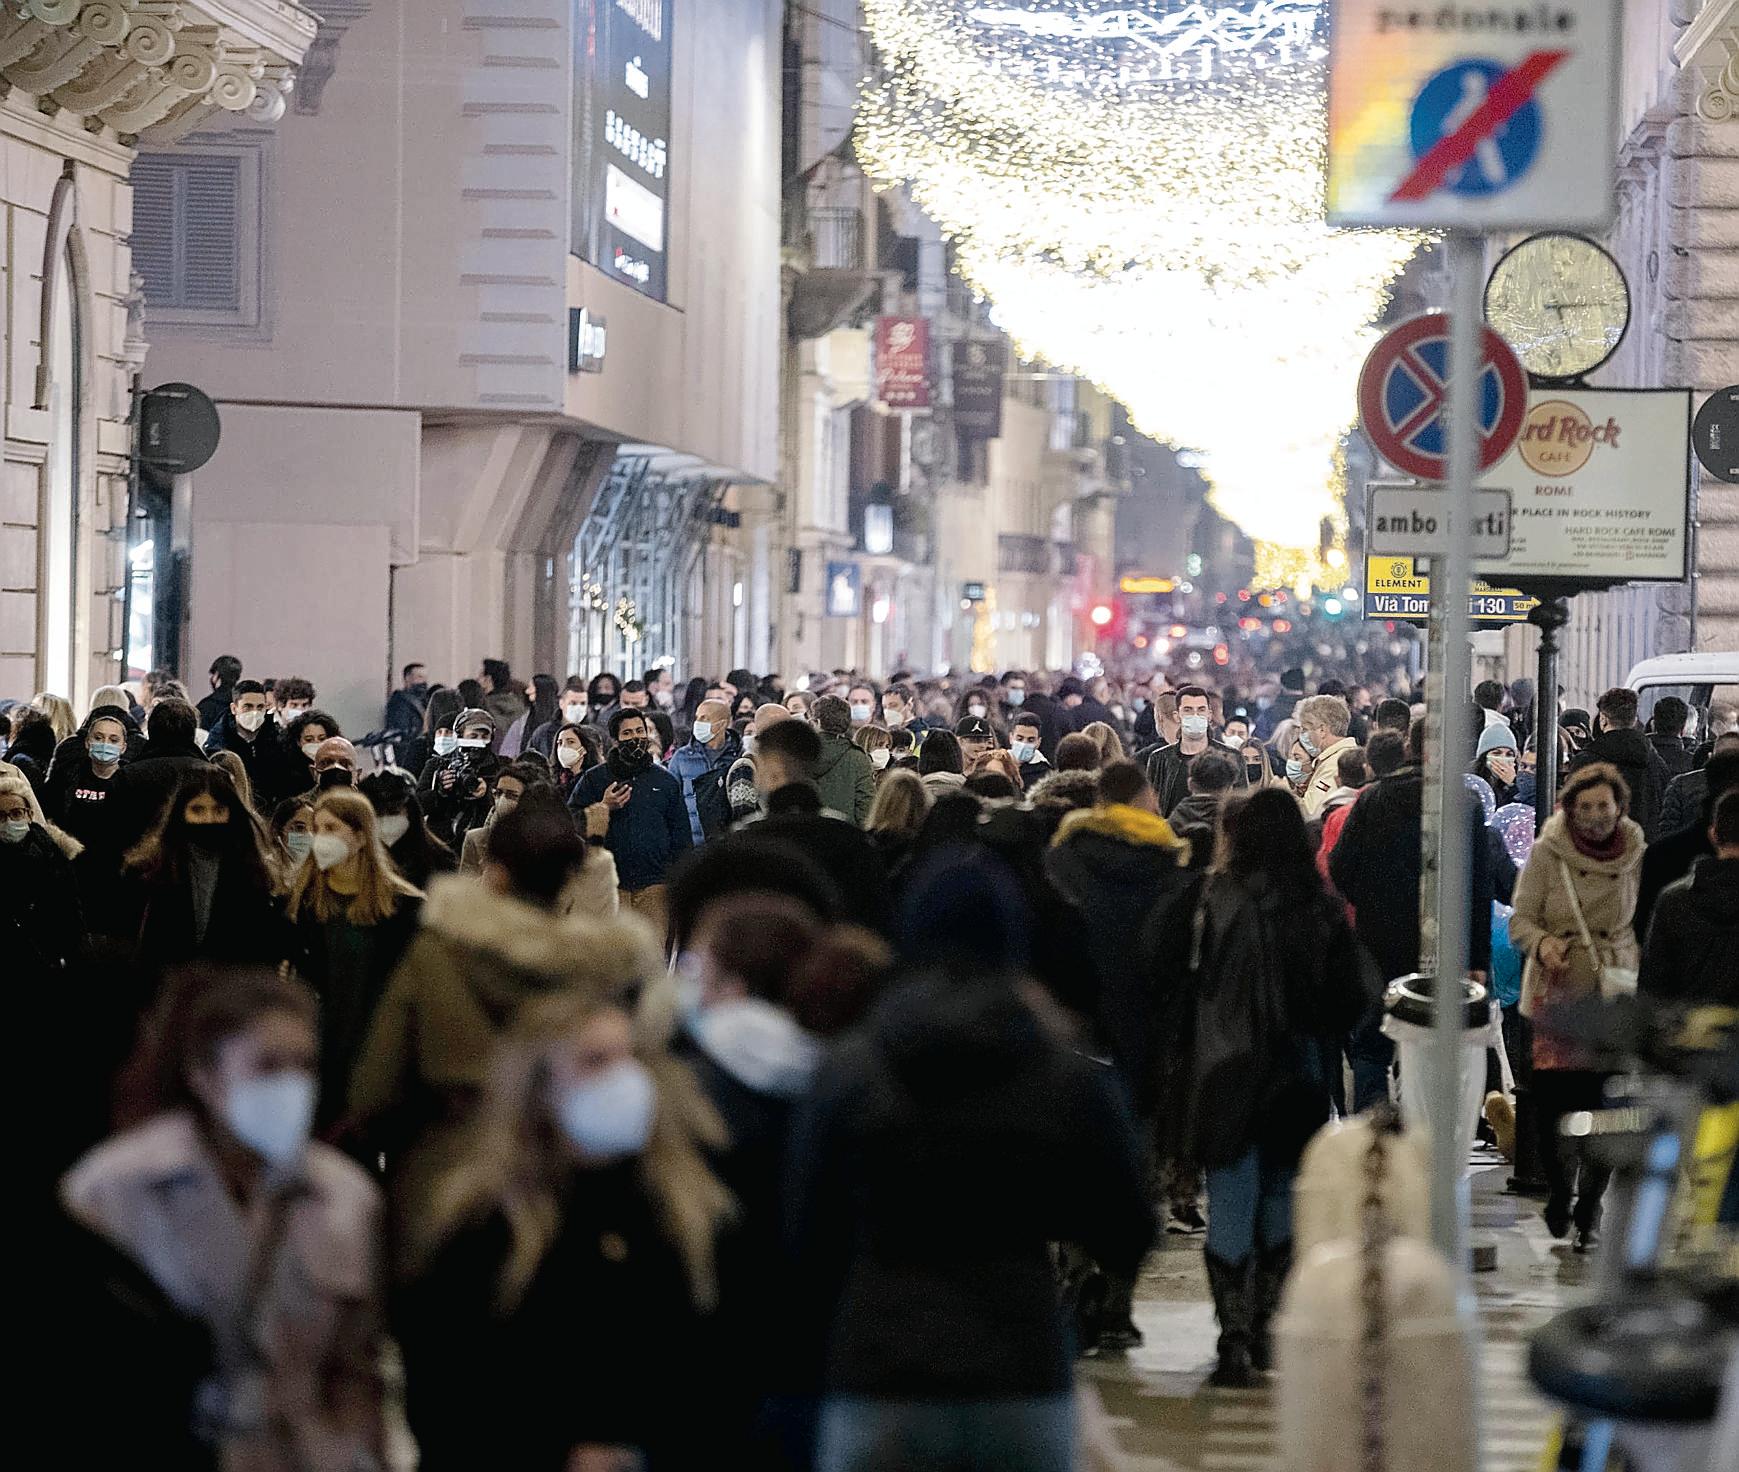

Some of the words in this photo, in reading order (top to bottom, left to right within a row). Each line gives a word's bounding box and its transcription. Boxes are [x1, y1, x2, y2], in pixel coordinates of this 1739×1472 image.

[1535, 485, 1574, 497] ROME
[1522, 507, 1552, 517] PLACE
[1557, 508, 1570, 517] IN
[1573, 508, 1601, 518] ROCK
[1606, 509, 1651, 519] HISTORY
[1376, 509, 1437, 535] ambo
[1648, 527, 1676, 537] ROME
[1375, 579, 1422, 588] ELEMENT
[1374, 595, 1398, 612] Via
[1477, 598, 1506, 614] 130
